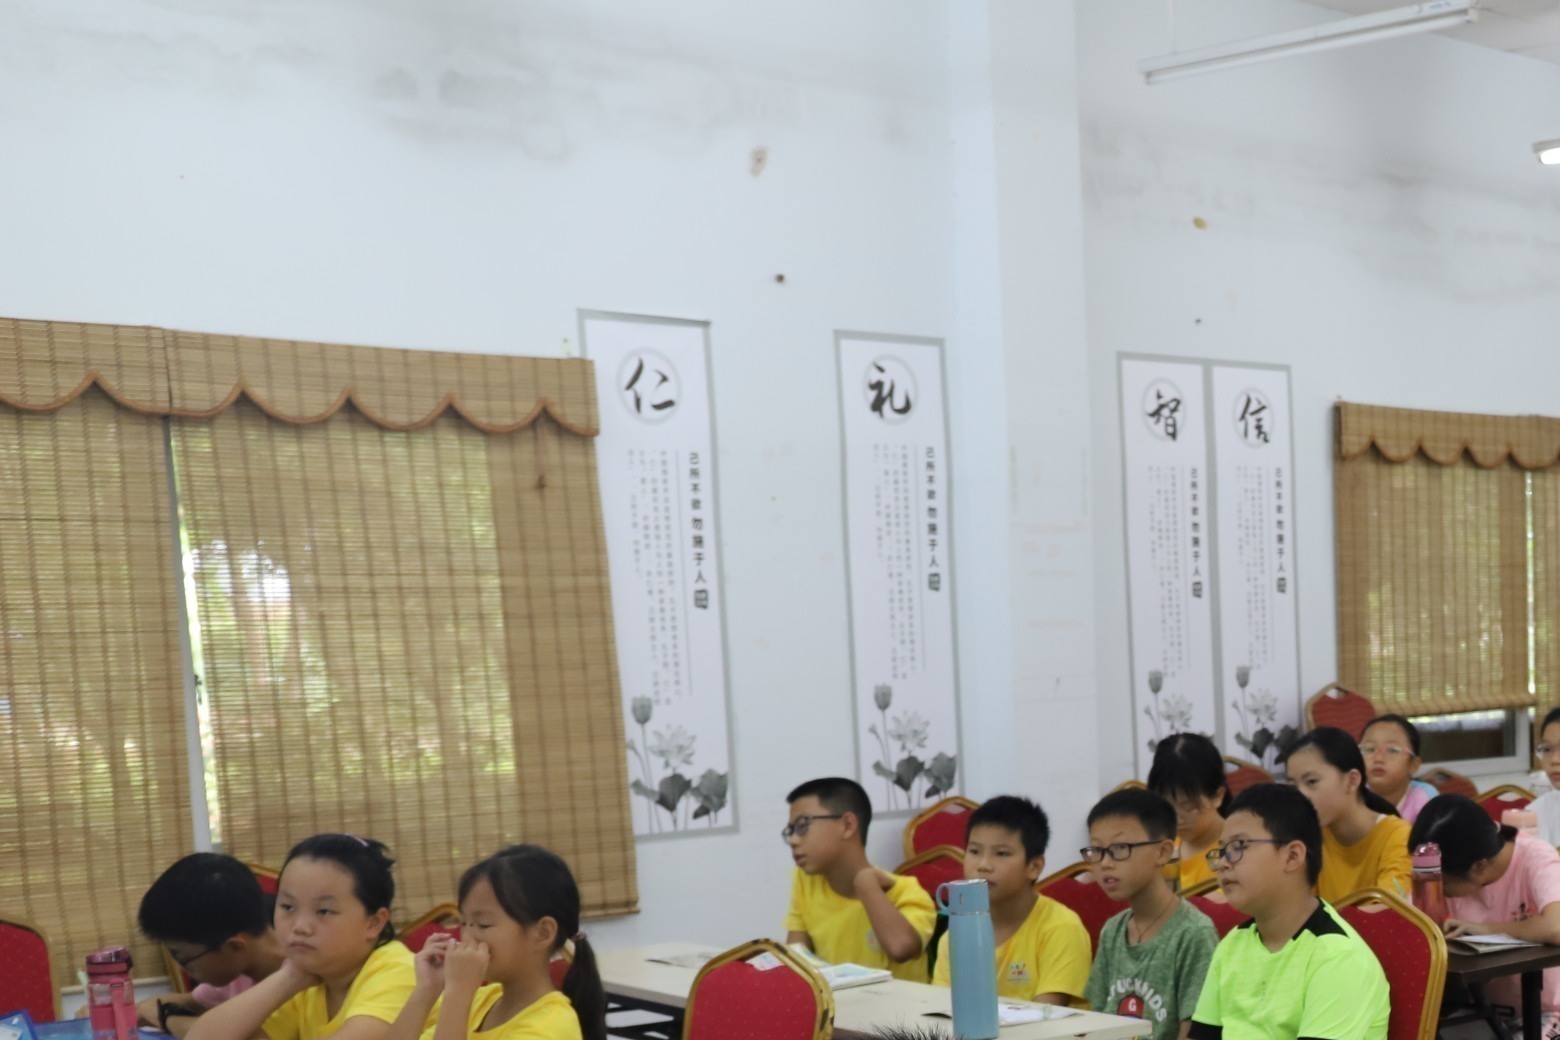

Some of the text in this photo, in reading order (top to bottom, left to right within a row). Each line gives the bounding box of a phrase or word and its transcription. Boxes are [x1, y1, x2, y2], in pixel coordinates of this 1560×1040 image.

[625, 357, 676, 414] 仁
[868, 362, 912, 418] 礼
[1147, 389, 1182, 441] 智
[1238, 393, 1270, 443] 信
[1128, 998, 1137, 1012] G
